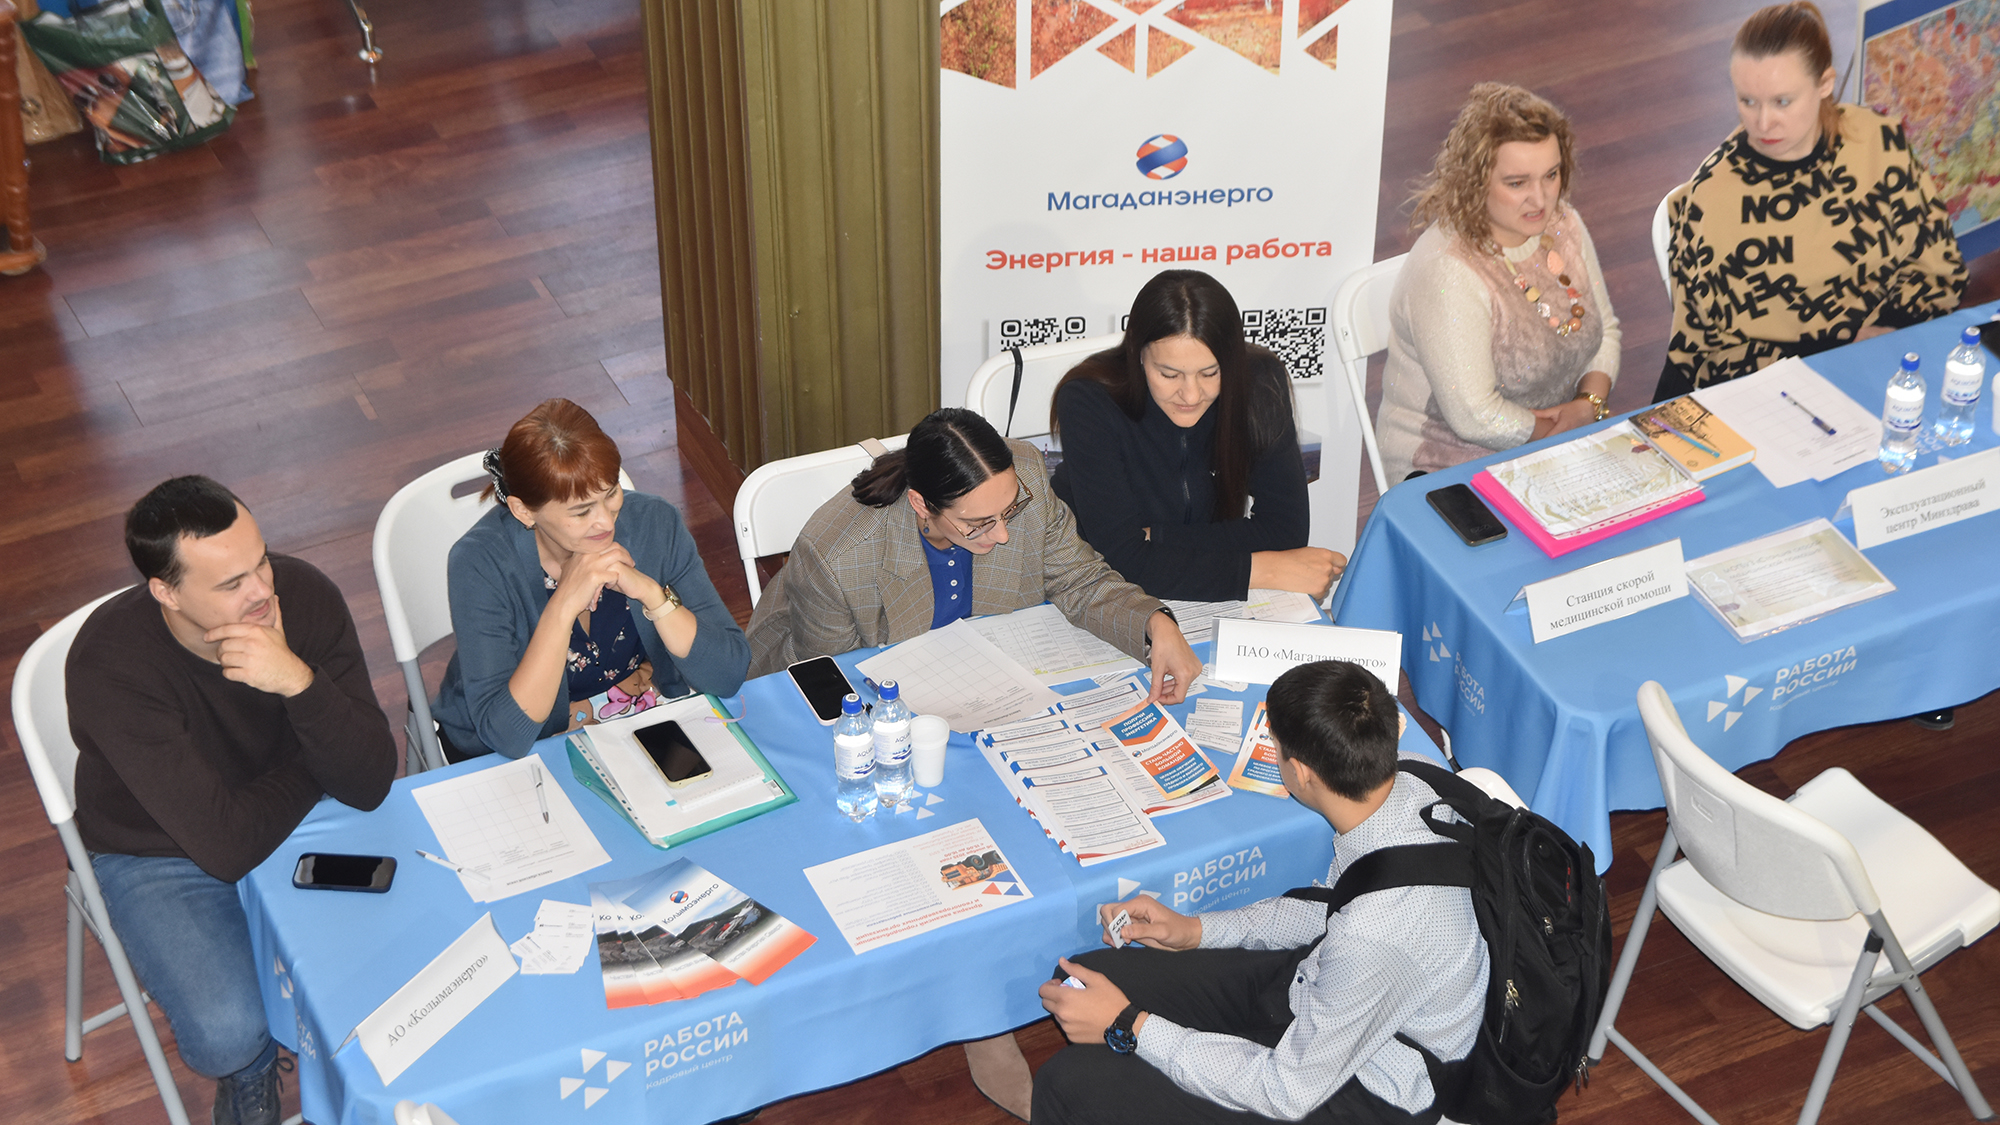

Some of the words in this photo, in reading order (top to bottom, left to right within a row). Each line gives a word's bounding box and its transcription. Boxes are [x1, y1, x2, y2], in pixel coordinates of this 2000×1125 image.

[1047, 184, 1274, 211] Магаданэнерго
[985, 248, 1114, 272] Энергия
[1141, 244, 1218, 262] наша
[1225, 236, 1333, 266] работа
[1880, 478, 1986, 519] Эксплуатационный
[1886, 517, 1918, 534] центр
[1920, 498, 1980, 523] Минздрава
[1566, 585, 1614, 607] Станция
[1616, 570, 1655, 588] скорой
[1550, 598, 1624, 630] медицинской
[1626, 584, 1672, 606] помощи
[1237, 644, 1269, 658] ПАО
[1273, 648, 1387, 668] «Магаданэнерго»
[1775, 645, 1856, 684] РАБОТА
[1771, 658, 1858, 700] РОССИИ
[1121, 712, 1155, 734] ПРОФЕССИЮ
[1123, 712, 1146, 727] ПОЛУЧИ
[1125, 717, 1158, 737] ЭНЕРГЕТИКА
[1145, 753, 1165, 766] СТАНЬ
[1162, 741, 1184, 757] ЧАСТЬЮ
[1154, 749, 1182, 767] БОЛЬШОЙ
[1158, 753, 1186, 771] КОМАНДЫ
[1173, 861, 1267, 907] РОССИИ
[1174, 845, 1263, 888] РАБОТА
[661, 883, 719, 926] Колымаэнерго
[1221, 886, 1251, 903] центр
[388, 1024, 407, 1047] АО
[407, 953, 490, 1028] «Колымаэнерго»
[644, 1011, 744, 1058] РАБОТА
[645, 1027, 748, 1077] РОССИИ
[701, 1054, 733, 1069] центр
